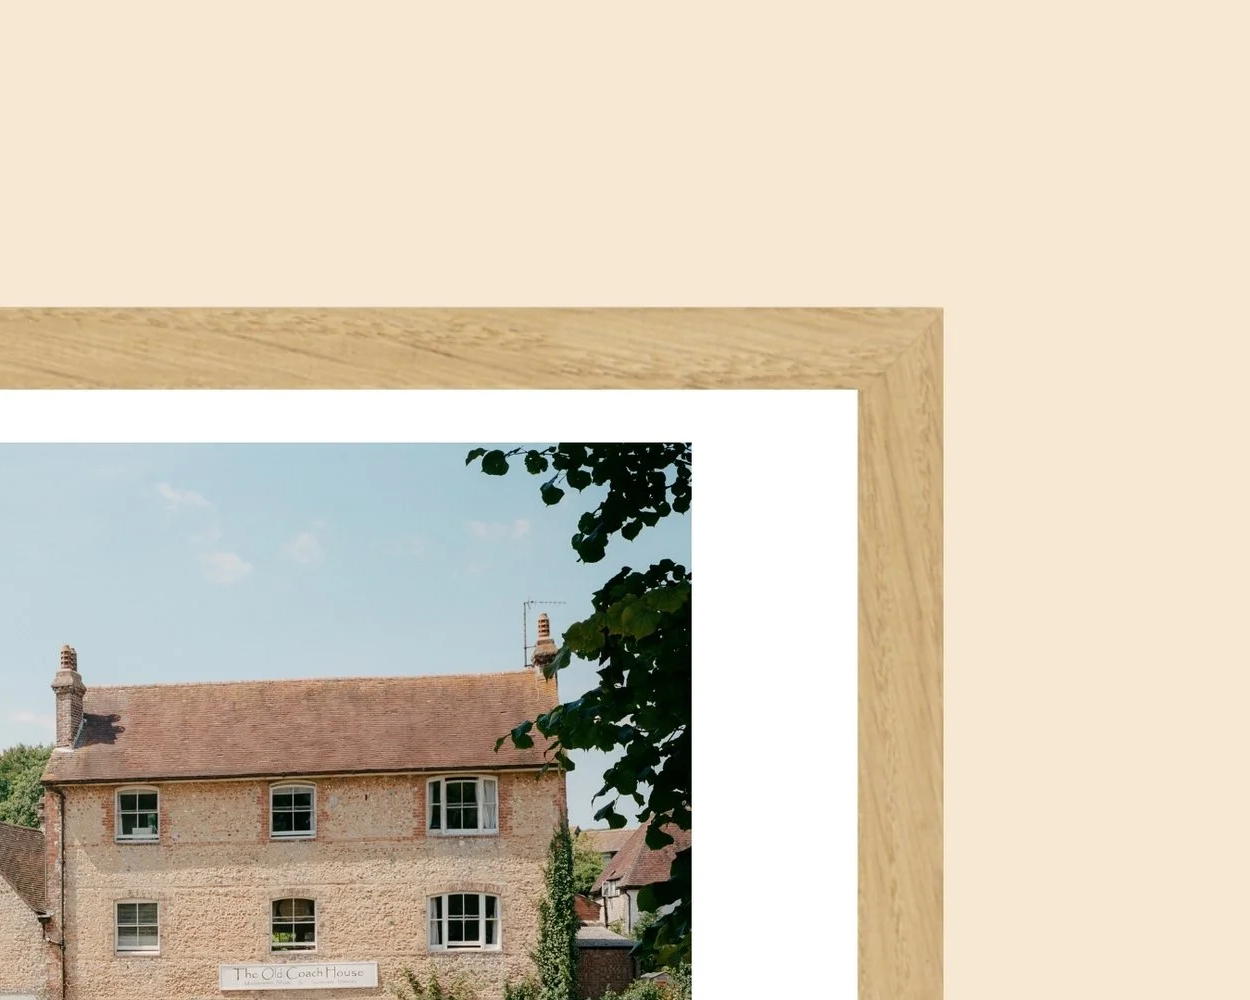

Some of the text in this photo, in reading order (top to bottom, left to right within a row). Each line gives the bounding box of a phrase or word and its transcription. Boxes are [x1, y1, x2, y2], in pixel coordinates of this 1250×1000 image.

[233, 965, 364, 981] The Old Coach House
